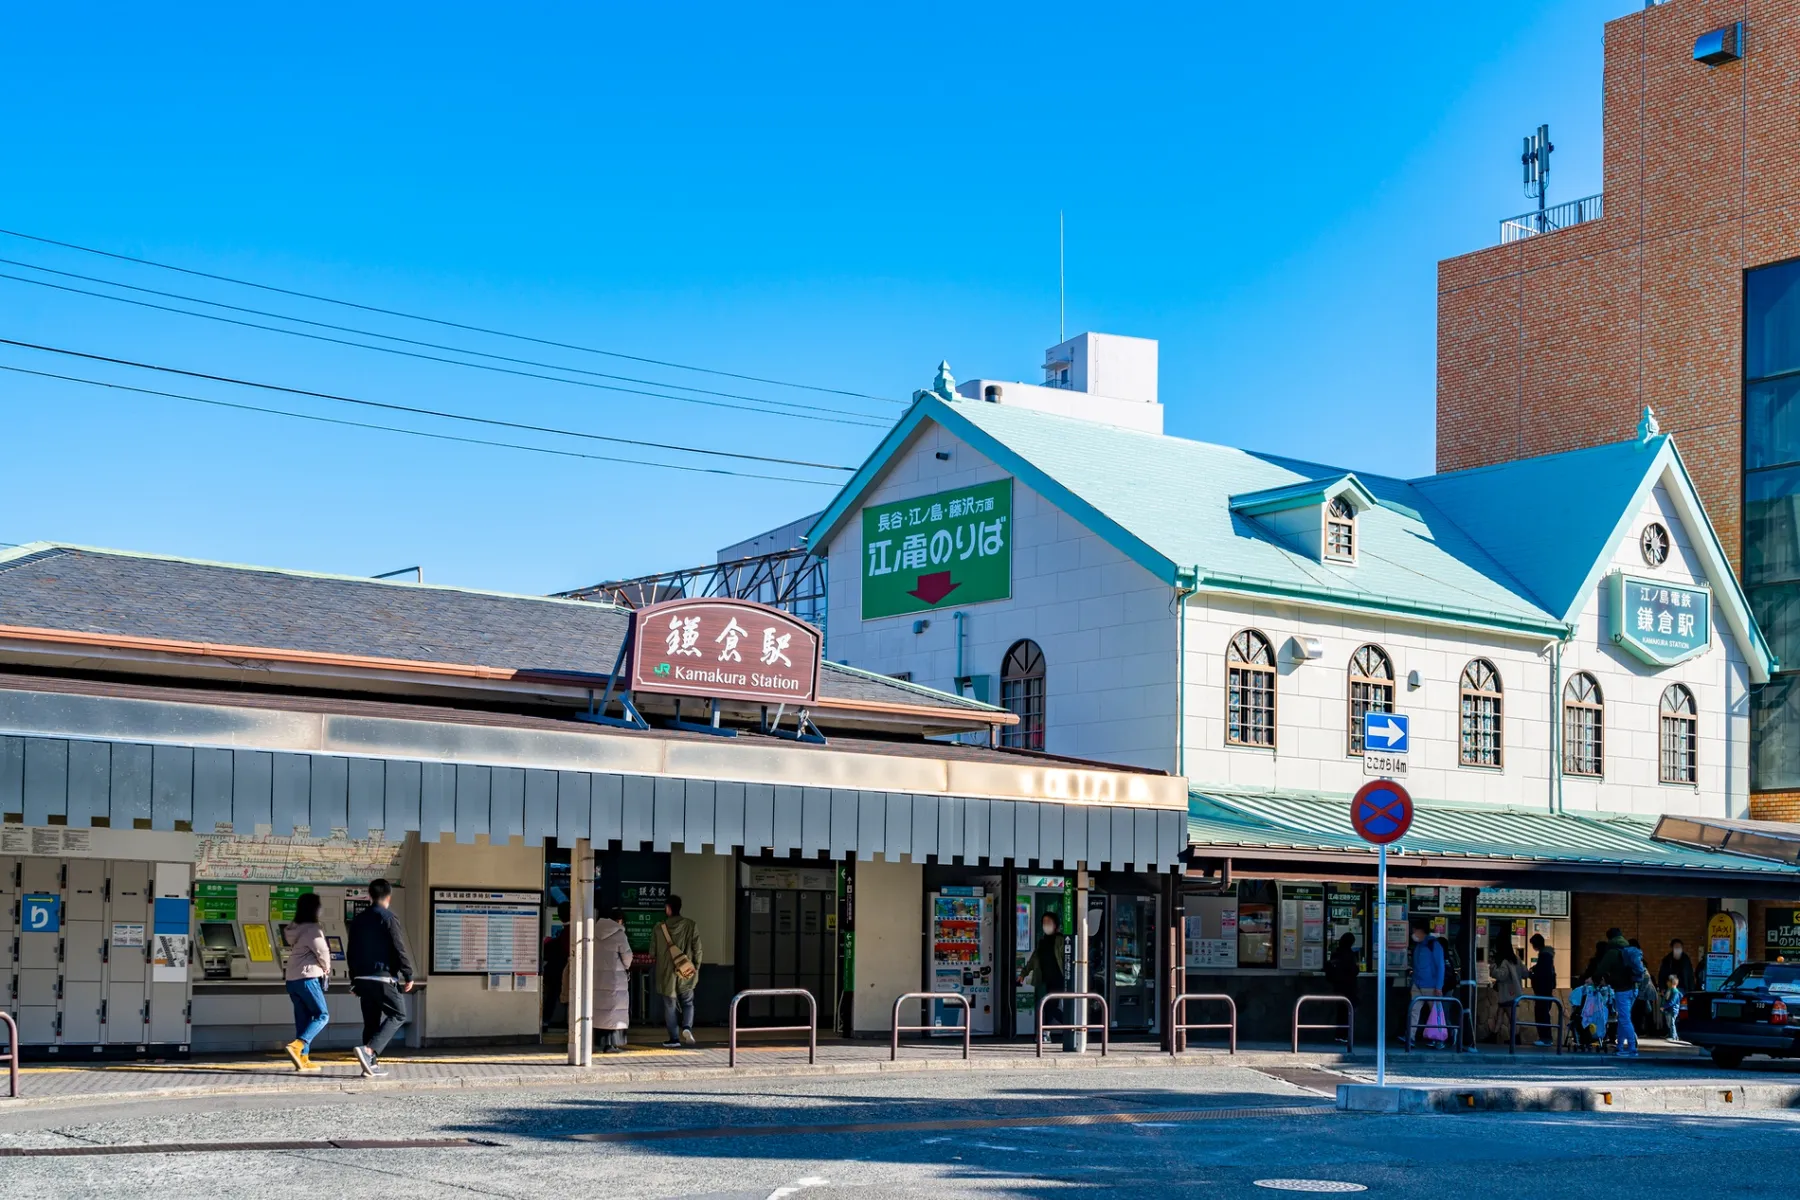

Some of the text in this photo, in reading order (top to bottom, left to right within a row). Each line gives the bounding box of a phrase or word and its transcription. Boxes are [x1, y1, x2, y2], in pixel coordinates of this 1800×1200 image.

[878, 497, 994, 532] 長谷・江ノ島・藤沢方面
[868, 515, 1007, 577] 江ノ電のりば
[1640, 587, 1691, 608] 江ノ島電鉄
[1636, 606, 1695, 638] 鎌倉駅
[665, 615, 792, 667] 鎌倉駅
[1642, 636, 1690, 649] KAMAKURA STATION
[653, 662, 799, 690] JR Kamakura Station
[1366, 756, 1407, 774] ここから14m
